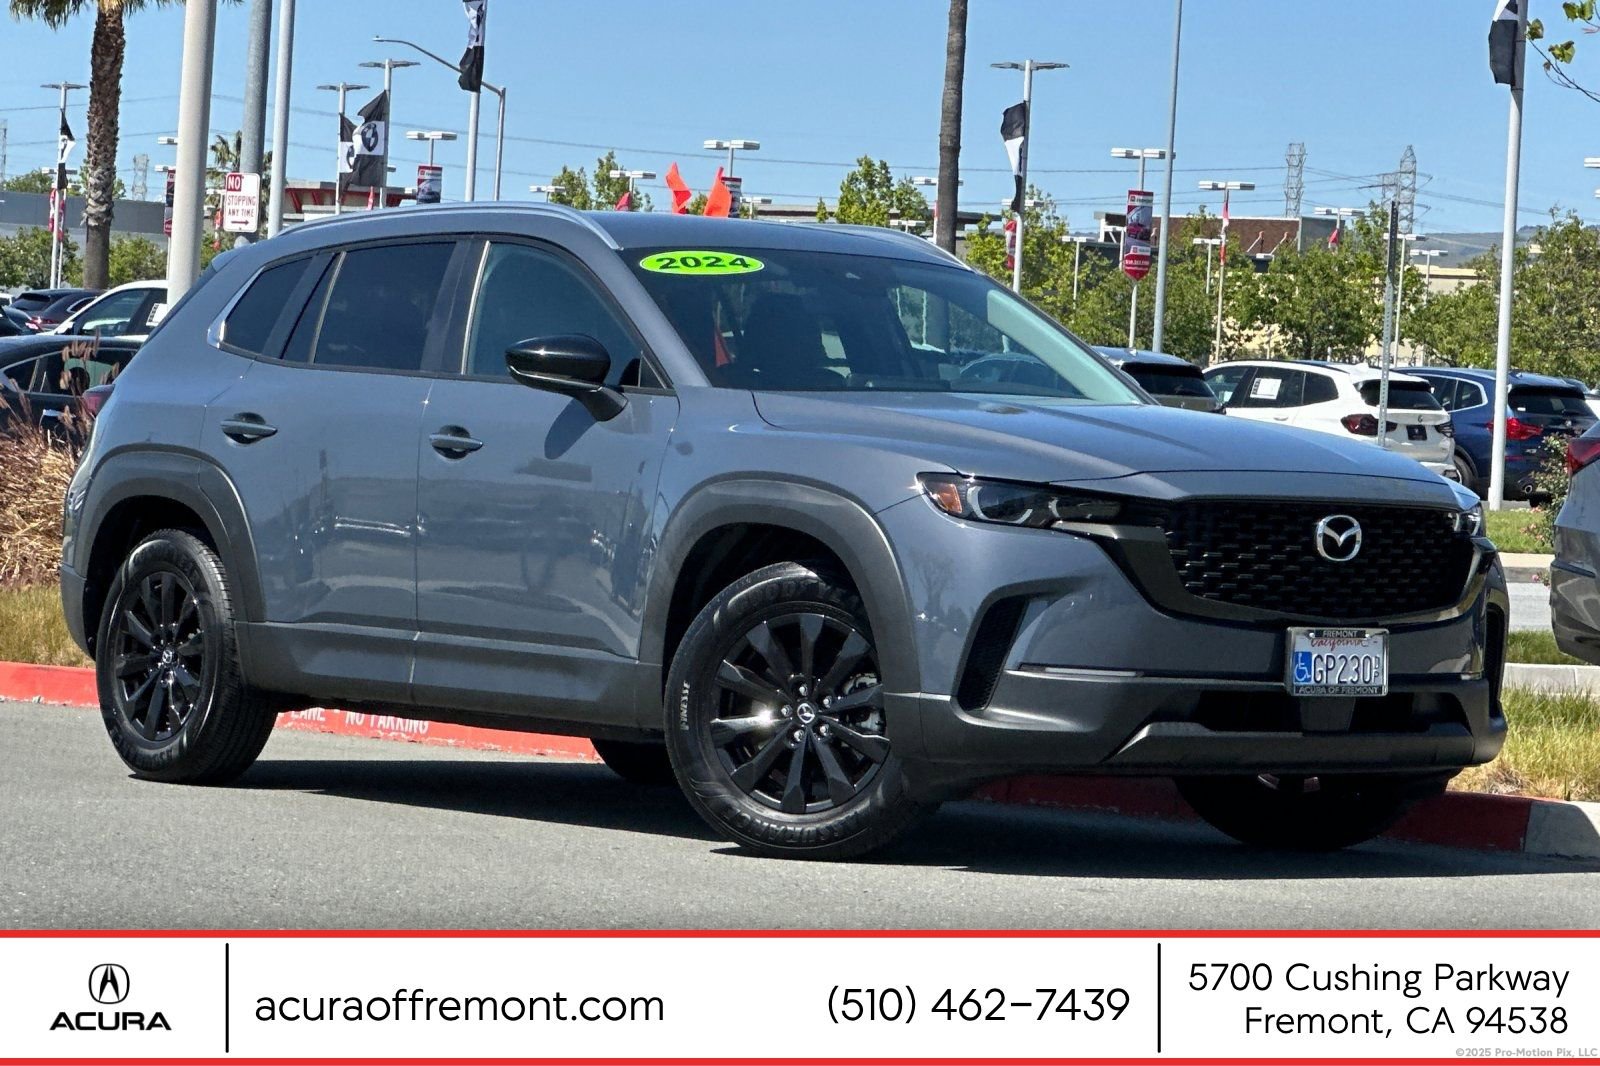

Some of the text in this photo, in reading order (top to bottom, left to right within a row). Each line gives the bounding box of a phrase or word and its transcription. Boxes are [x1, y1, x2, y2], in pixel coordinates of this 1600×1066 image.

[227, 175, 241, 190] NO
[227, 195, 256, 206] STOPPING
[228, 208, 254, 218] ANY TIME
[655, 256, 751, 270] 2024
[1322, 630, 1358, 638] FREMONT
[1313, 654, 1372, 684] GP230
[1299, 686, 1379, 694] ACURA OF FREMONT
